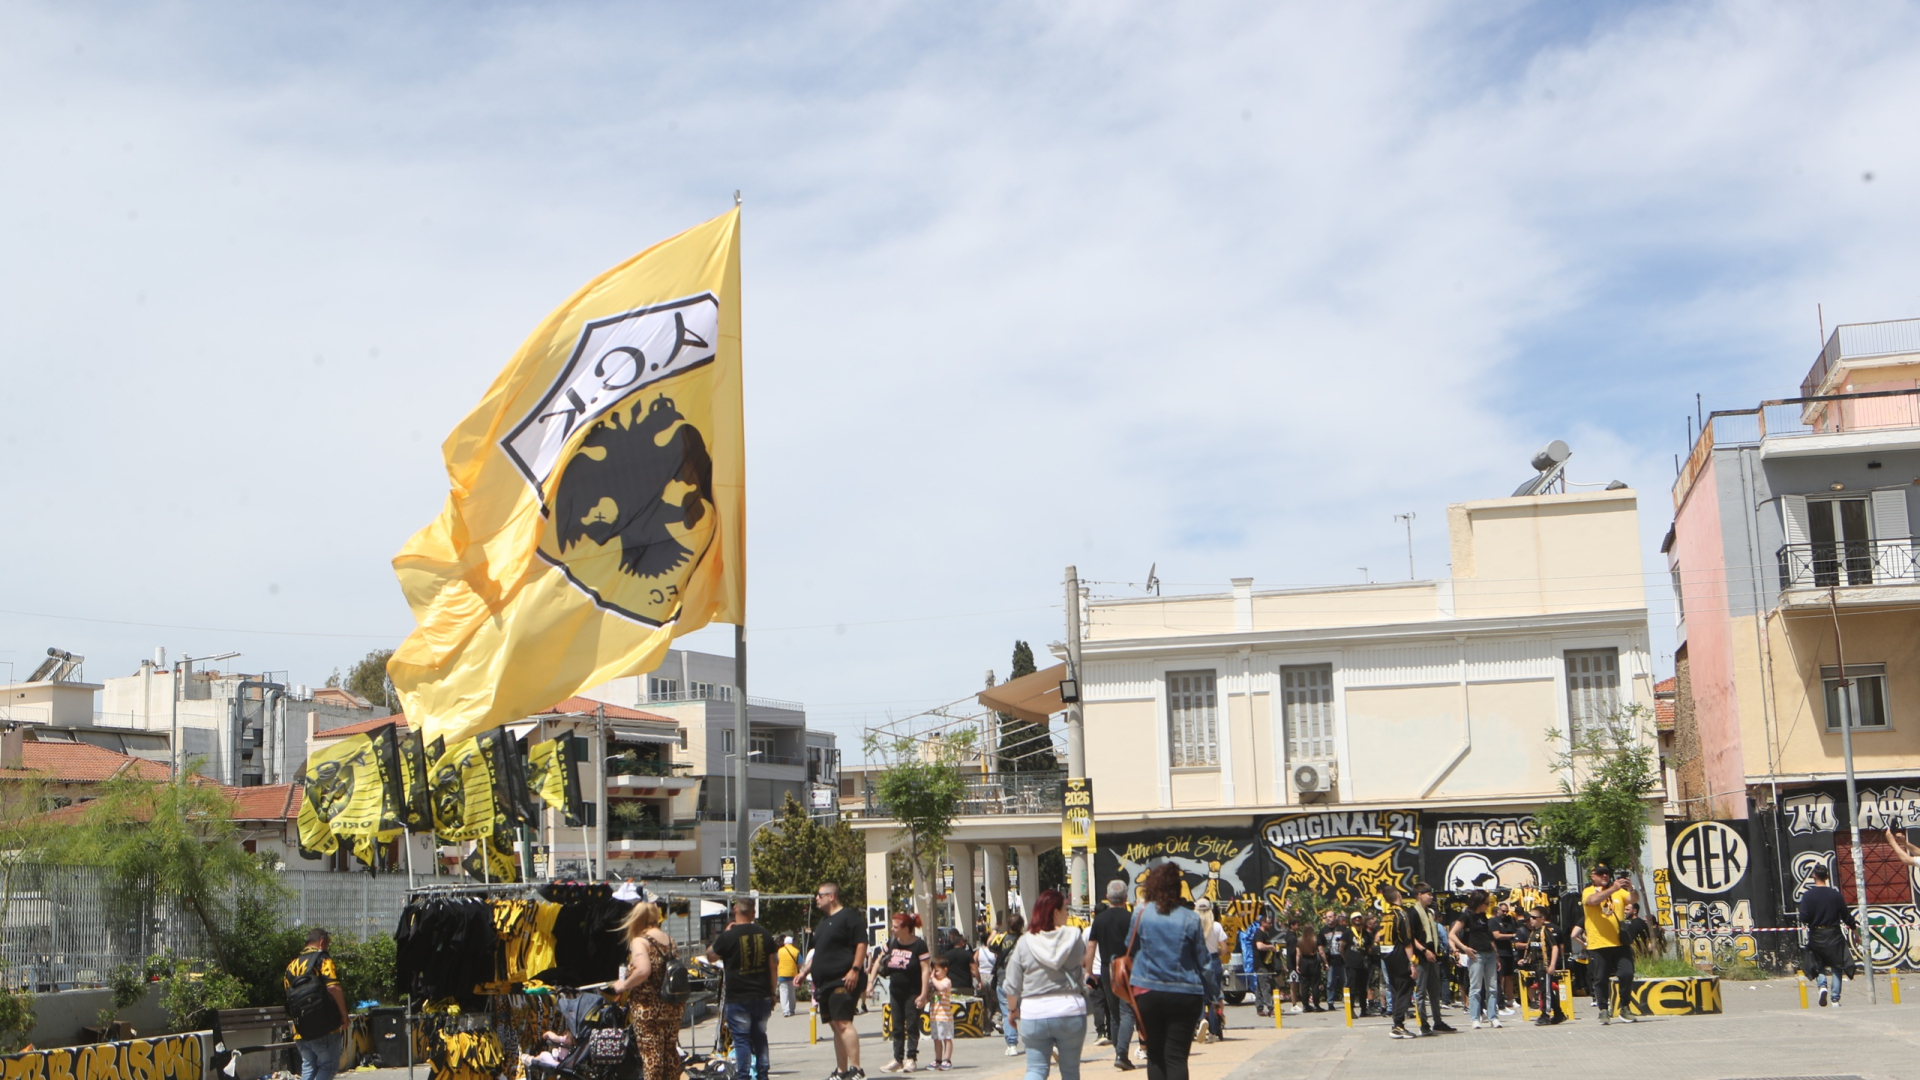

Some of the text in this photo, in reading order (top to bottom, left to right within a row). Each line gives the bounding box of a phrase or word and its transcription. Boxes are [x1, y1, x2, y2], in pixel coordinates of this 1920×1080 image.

[1064, 791, 1090, 806] 2026
[1266, 812, 1415, 847] ORIGINAL 21
[1165, 835, 1192, 854] Old
[1194, 836, 1239, 860] Style
